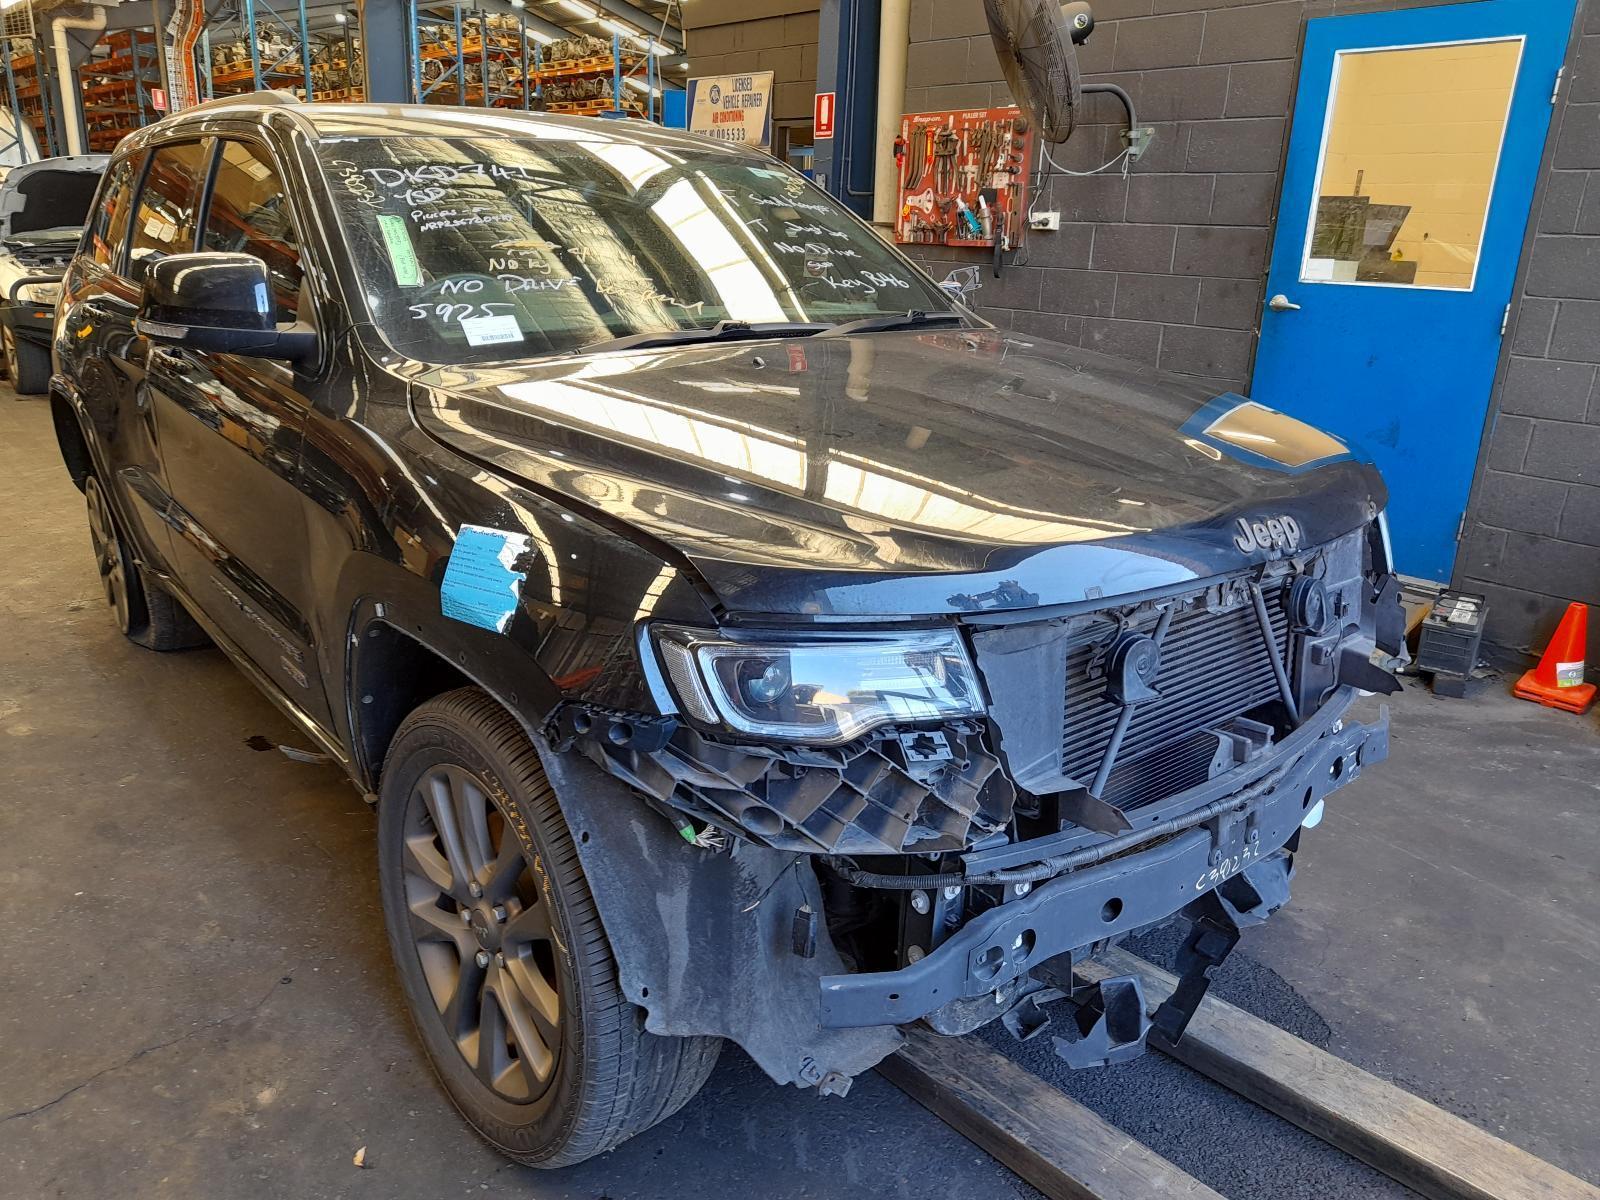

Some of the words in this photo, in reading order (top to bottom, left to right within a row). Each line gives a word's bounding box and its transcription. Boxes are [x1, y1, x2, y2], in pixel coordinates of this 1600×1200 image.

[732, 77, 752, 92] LICENSED
[723, 94, 739, 109] VEHICLE
[741, 92, 762, 108] REPAIRER
[912, 115, 941, 123] Snap-on
[408, 302, 516, 323] 5925
[1233, 515, 1300, 554] Jeep
